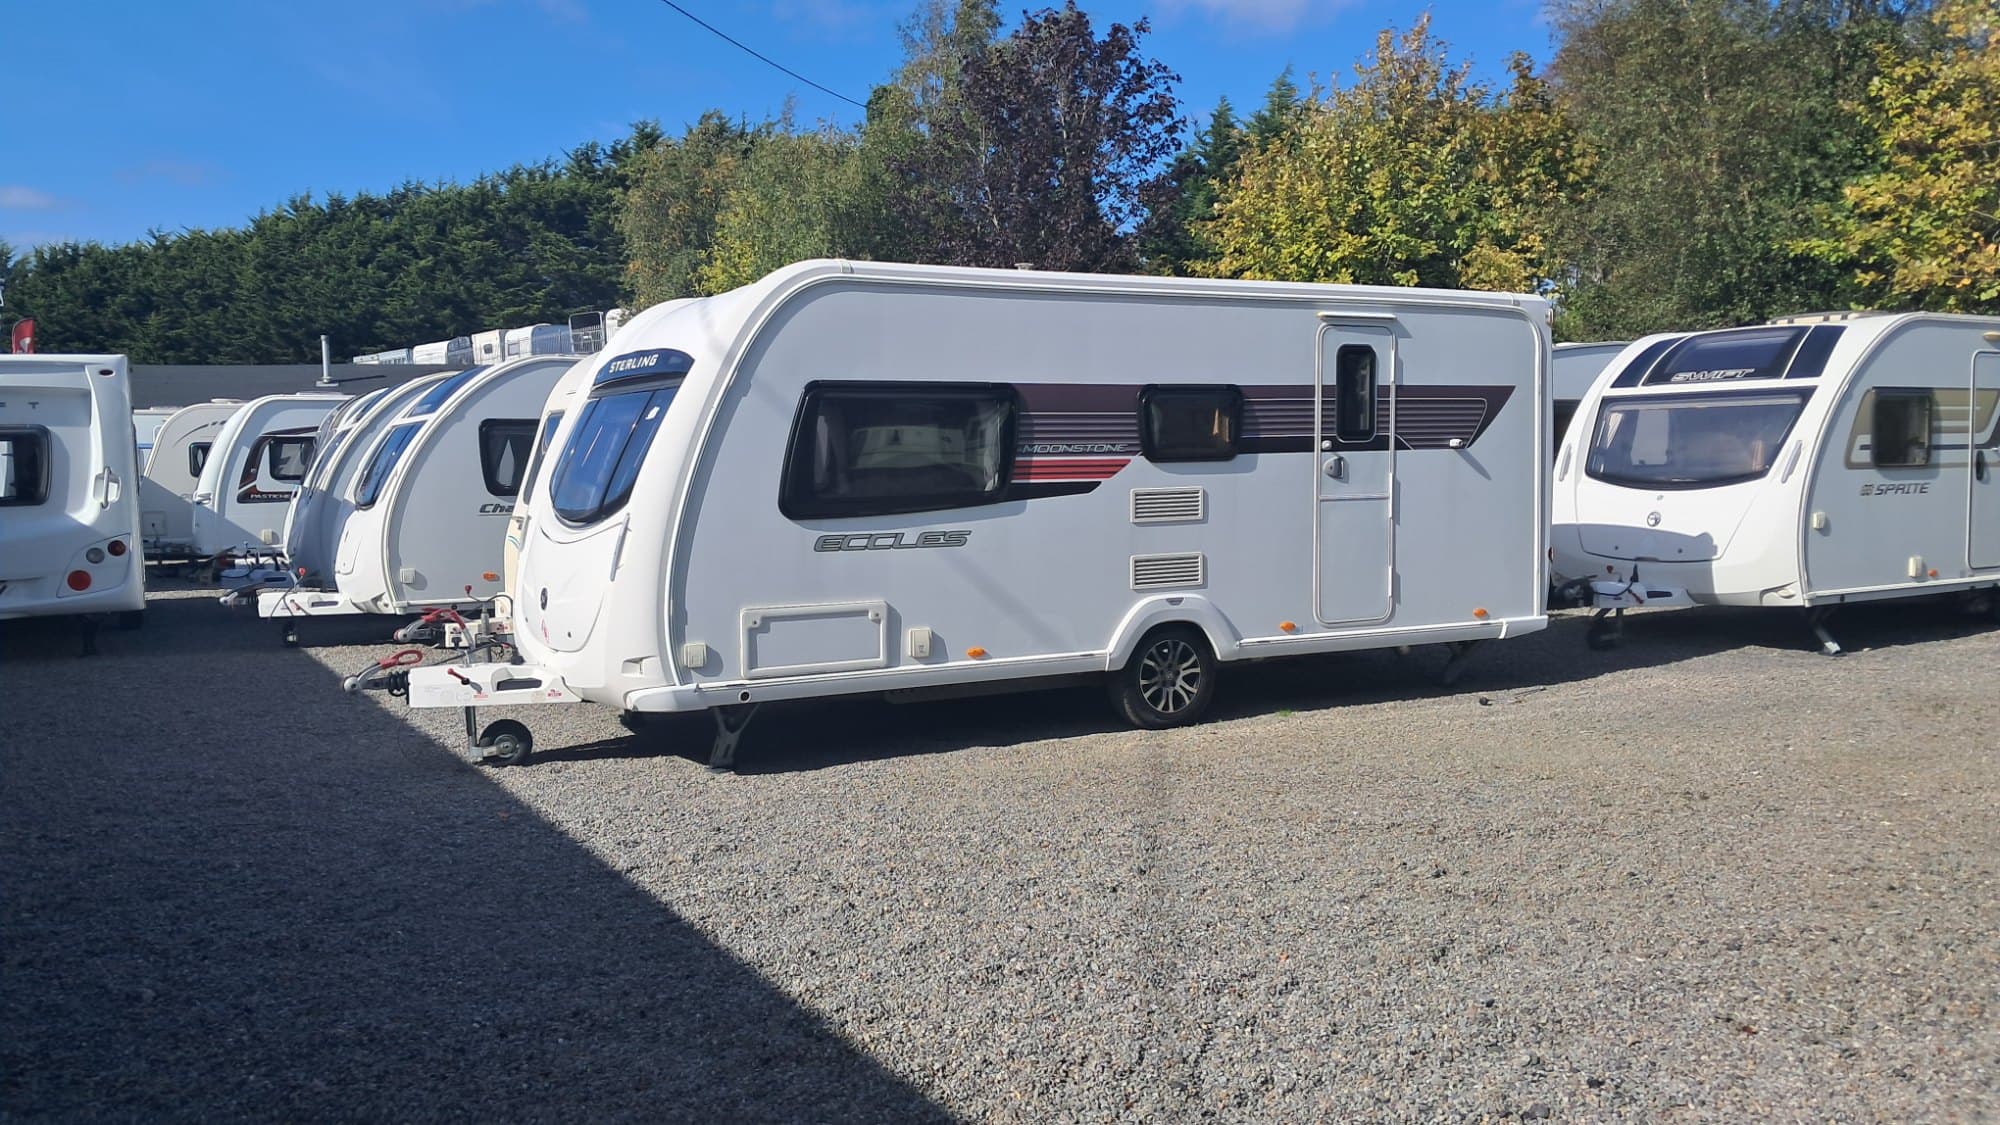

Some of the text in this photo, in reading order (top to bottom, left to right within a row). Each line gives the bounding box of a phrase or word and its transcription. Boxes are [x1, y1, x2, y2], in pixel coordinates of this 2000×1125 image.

[609, 354, 659, 373] STERLING
[1671, 368, 1755, 381] SWIFT
[1023, 444, 1128, 453] MOONSTONE
[1874, 482, 1931, 496] SPRITE
[814, 530, 972, 552] ECCLES
